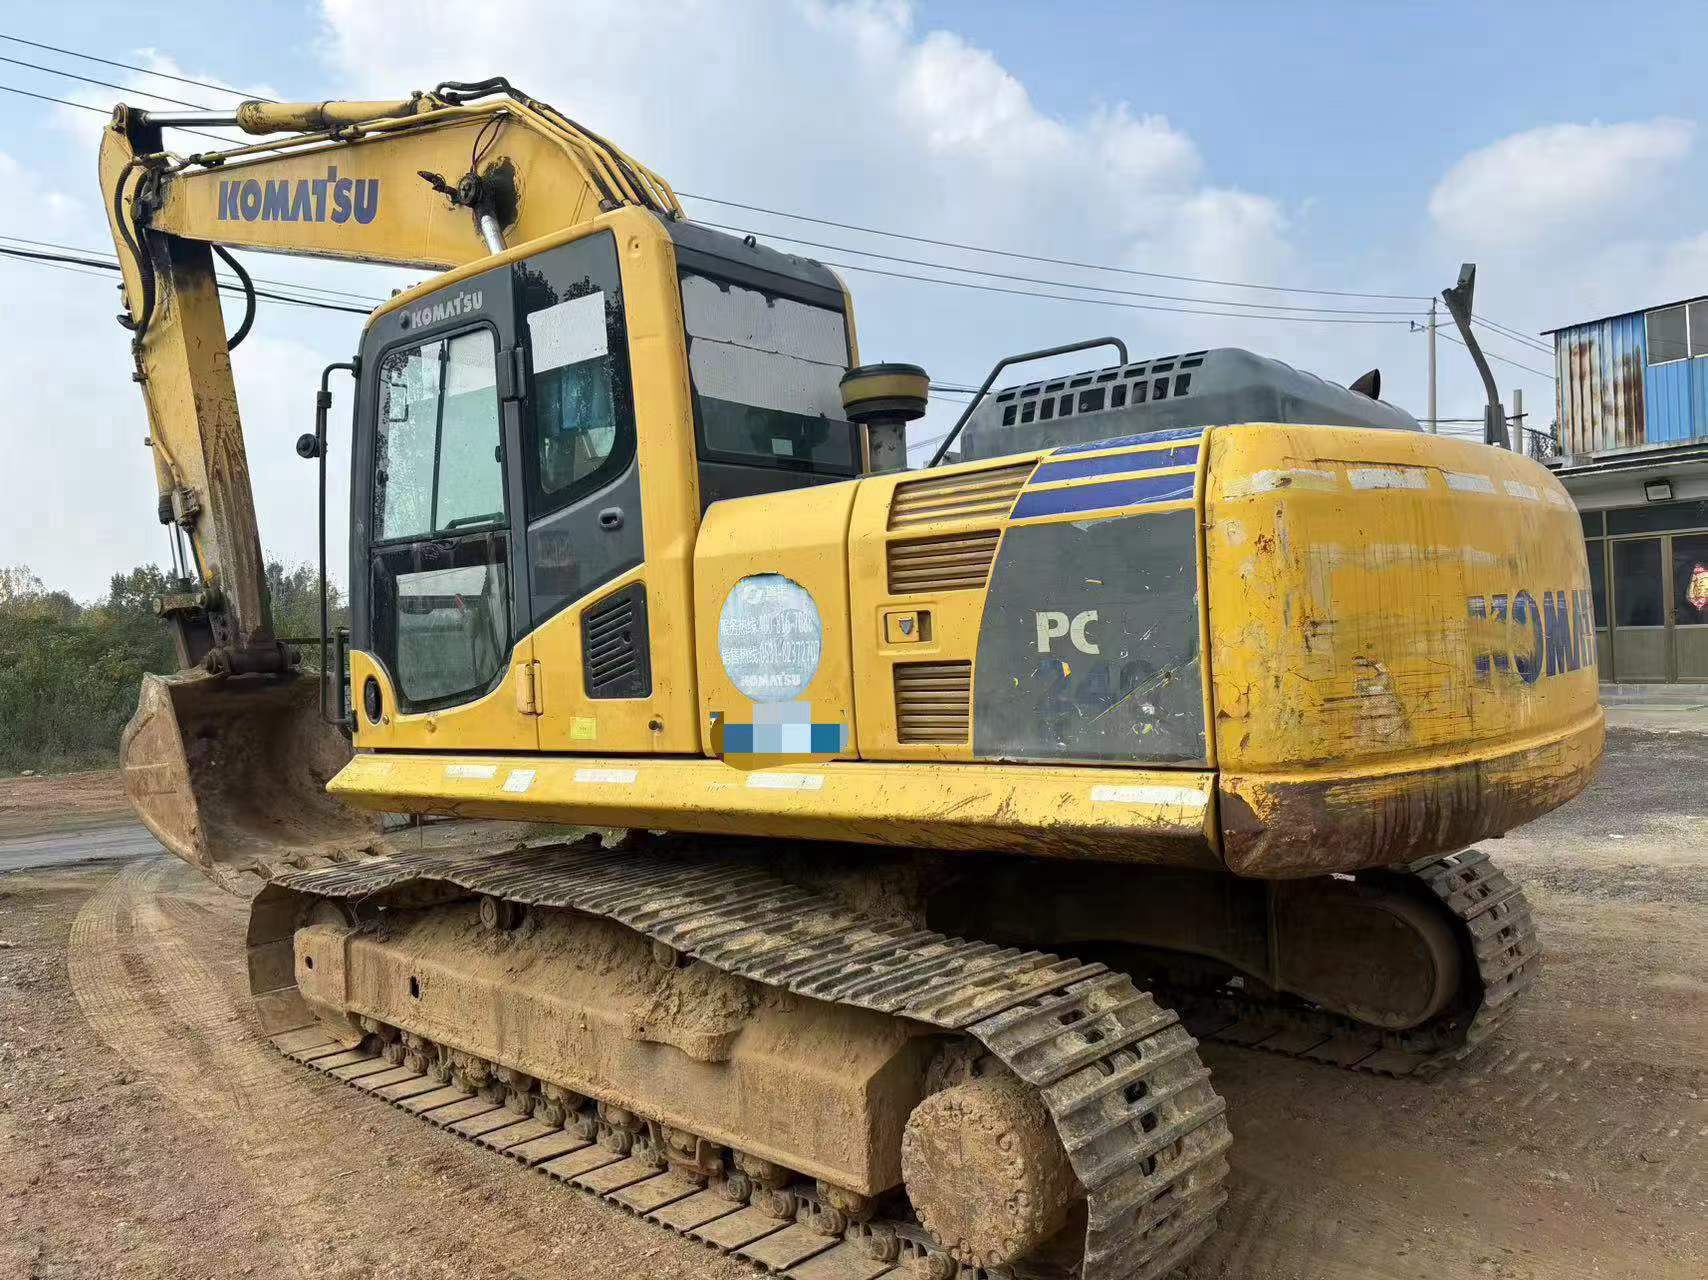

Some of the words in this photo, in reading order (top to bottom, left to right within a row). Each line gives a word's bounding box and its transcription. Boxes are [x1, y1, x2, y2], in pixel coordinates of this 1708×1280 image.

[218, 166, 379, 224] KOMATSU
[411, 291, 482, 329] KOMATSU
[1036, 610, 1100, 655] PC
